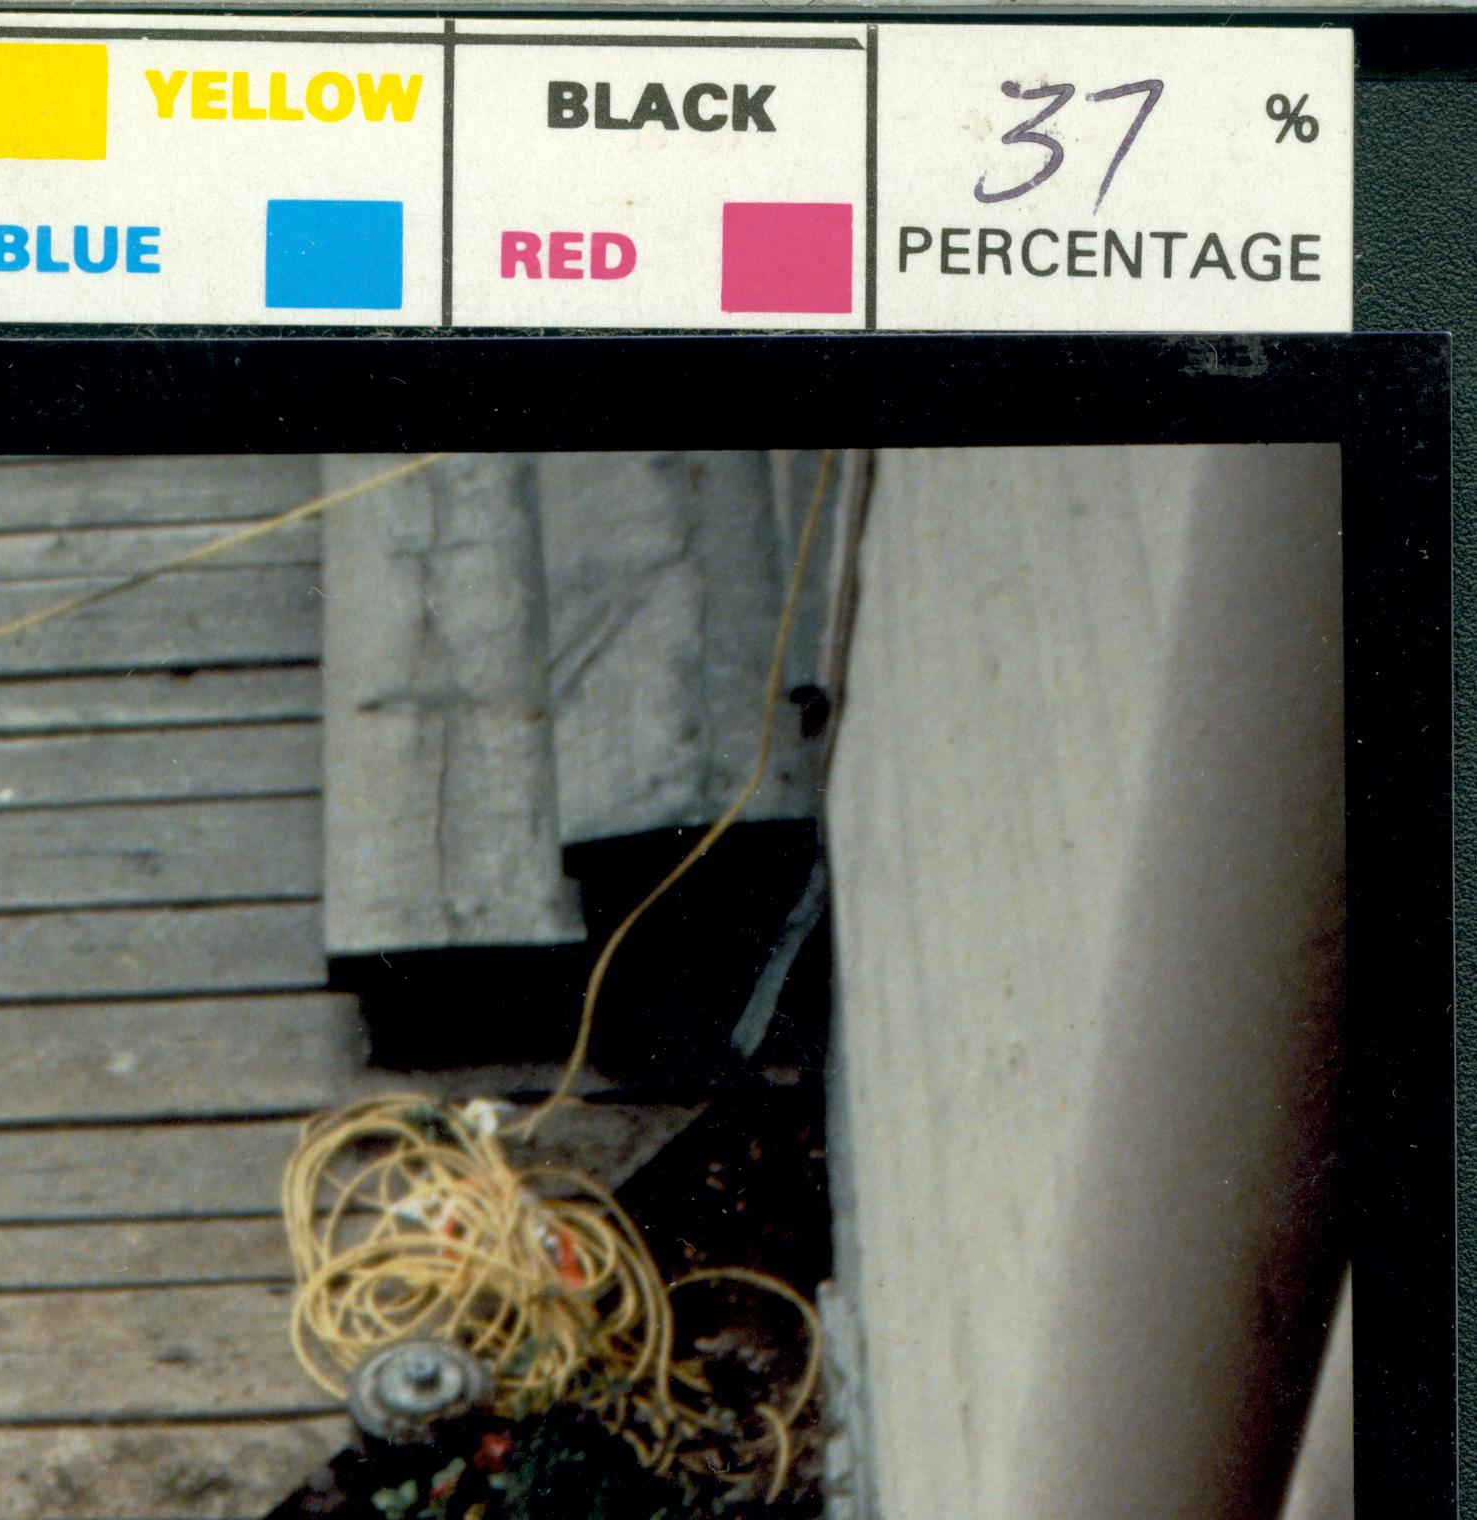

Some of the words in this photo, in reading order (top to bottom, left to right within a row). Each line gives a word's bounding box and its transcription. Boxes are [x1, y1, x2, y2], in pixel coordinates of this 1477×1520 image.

[144, 69, 423, 123] YELLOW
[547, 81, 776, 133] BLACK
[1266, 93, 1319, 144] %
[974, 79, 1164, 214] 37
[500, 231, 638, 280] RED
[899, 226, 1321, 282] PERCENTAGE
